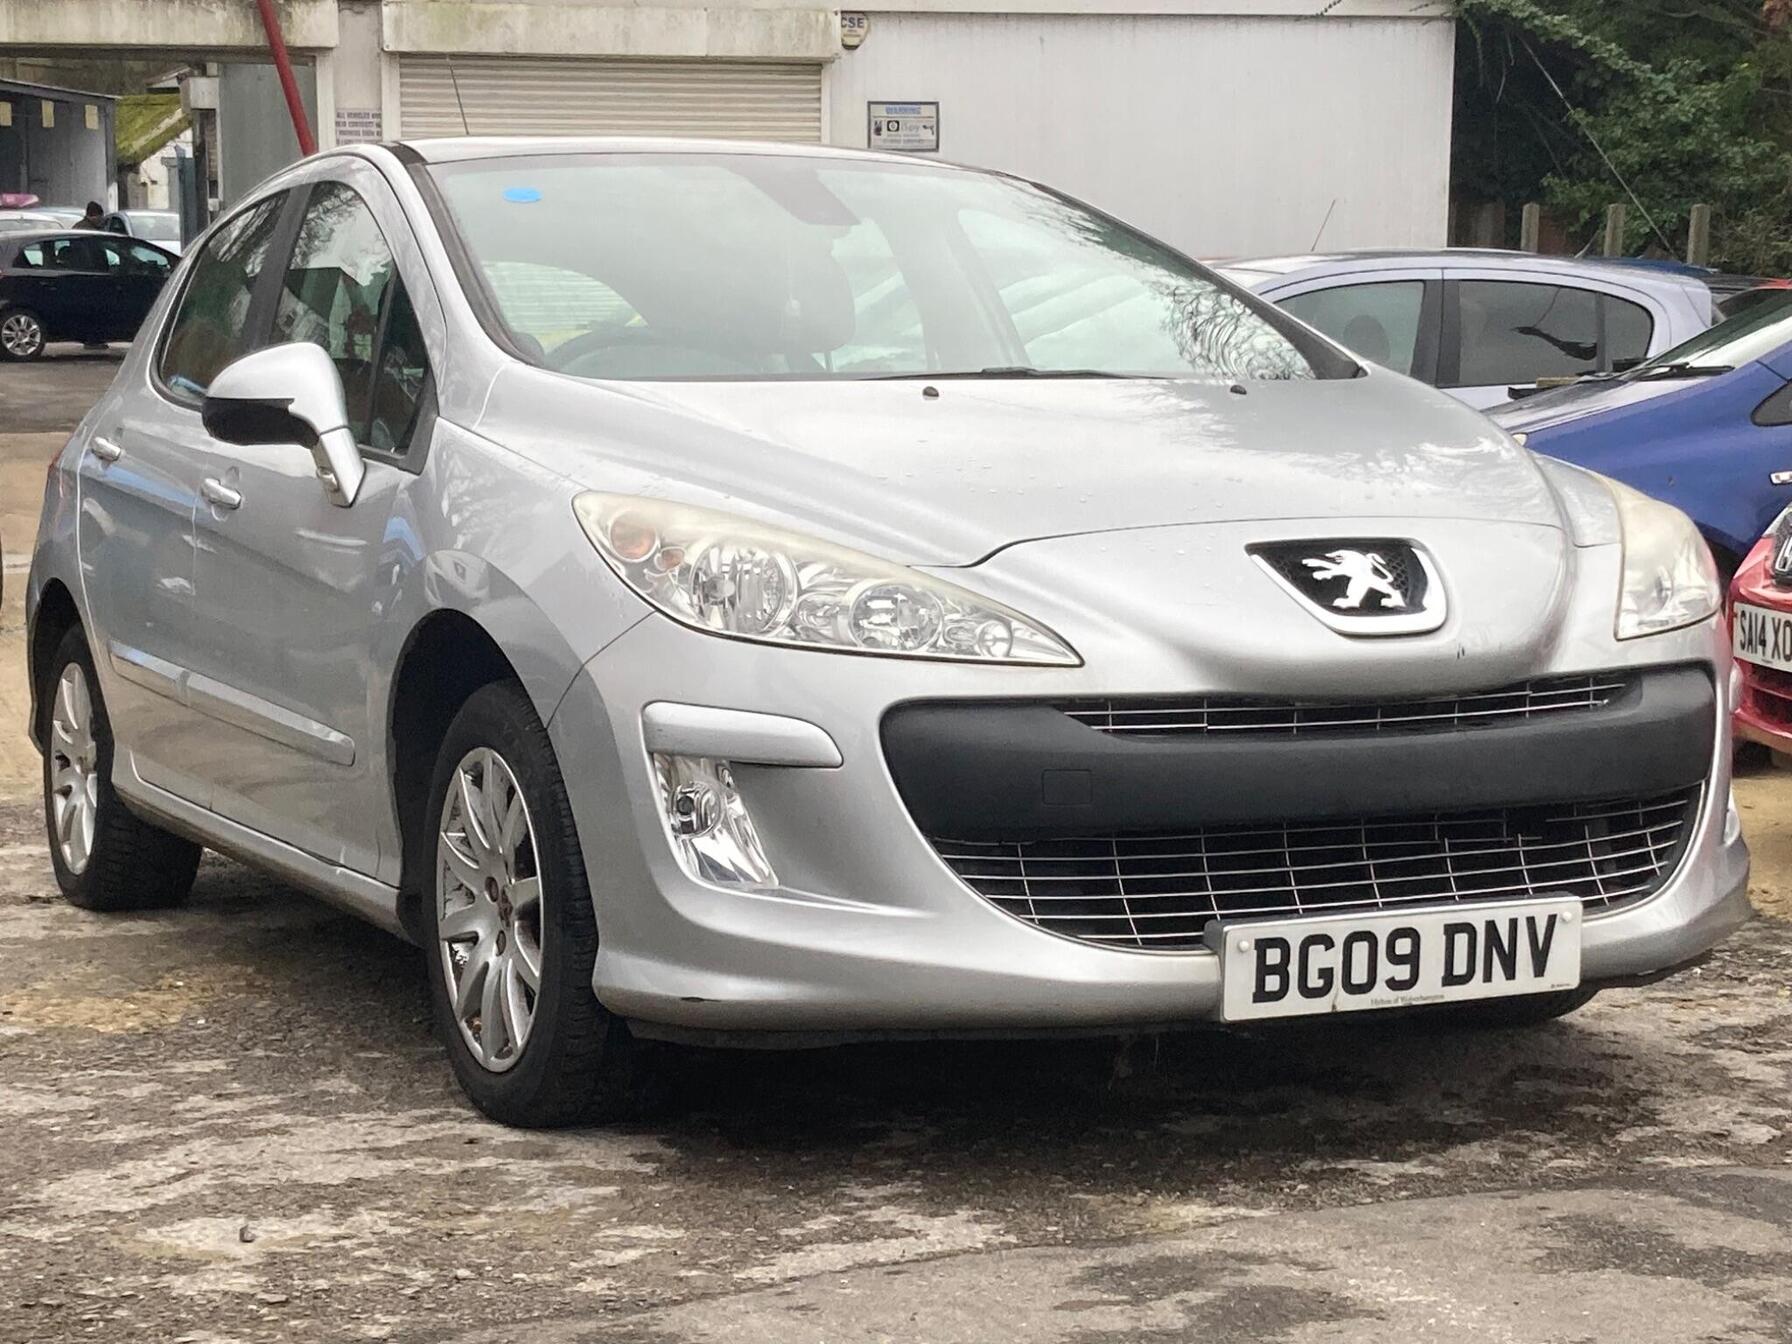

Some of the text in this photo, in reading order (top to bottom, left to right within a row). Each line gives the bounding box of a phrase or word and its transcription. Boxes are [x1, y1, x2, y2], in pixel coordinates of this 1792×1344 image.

[841, 16, 864, 28] CSE
[1740, 610, 1766, 657] SA14
[1253, 914, 1558, 1003] BG09 DNV
